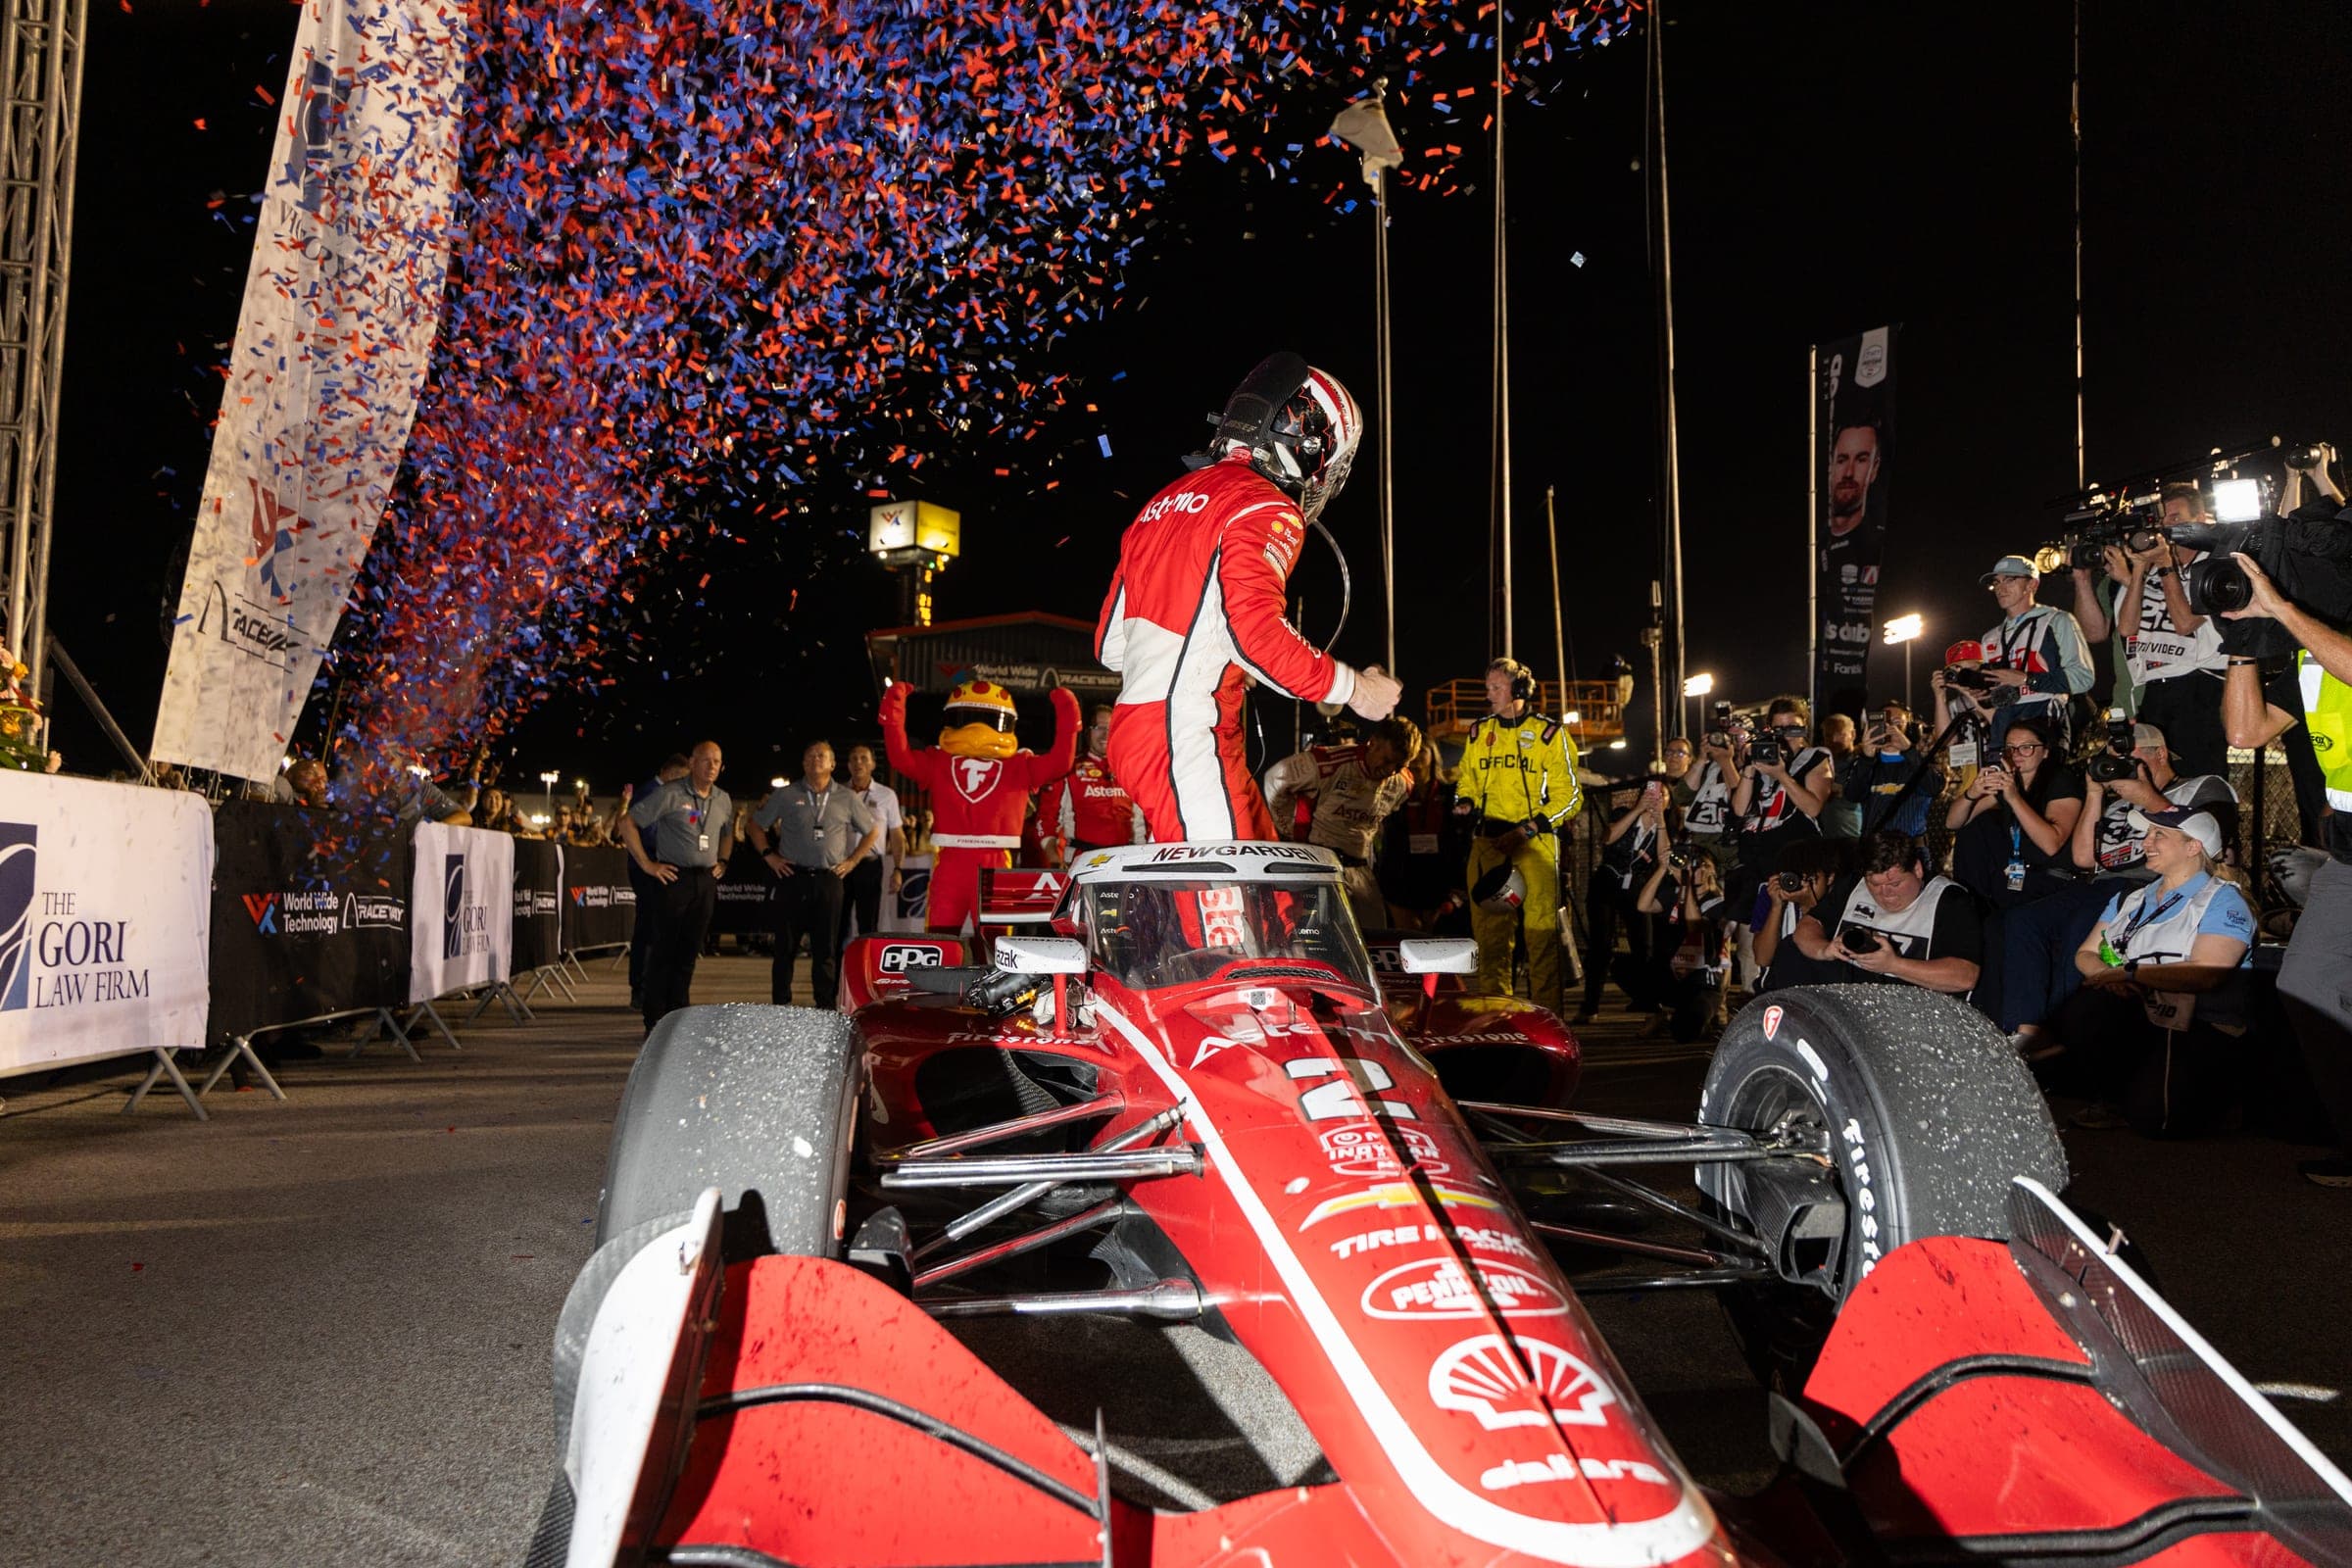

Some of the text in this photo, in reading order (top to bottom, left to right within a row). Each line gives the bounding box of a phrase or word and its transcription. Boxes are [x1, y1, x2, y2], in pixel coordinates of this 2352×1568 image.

[1479, 754, 1537, 773] OFFICIAL
[1084, 785, 1129, 798] Astem
[1152, 845, 1320, 862] NEWGARDEN
[42, 892, 75, 915] THE
[283, 891, 339, 911] World Wide
[283, 905, 405, 934] Technology RACEWAY
[463, 906, 488, 932] GORI
[39, 921, 126, 967] GORI
[886, 948, 938, 970] PPG
[35, 969, 149, 1008] LAW FIRM
[947, 1032, 1091, 1046] Firestone
[1282, 1057, 1419, 1122] 2
[1329, 1145, 1440, 1161] INDYAR
[1330, 1226, 1420, 1260] TIRE
[1390, 1273, 1541, 1311] PENNOIL
